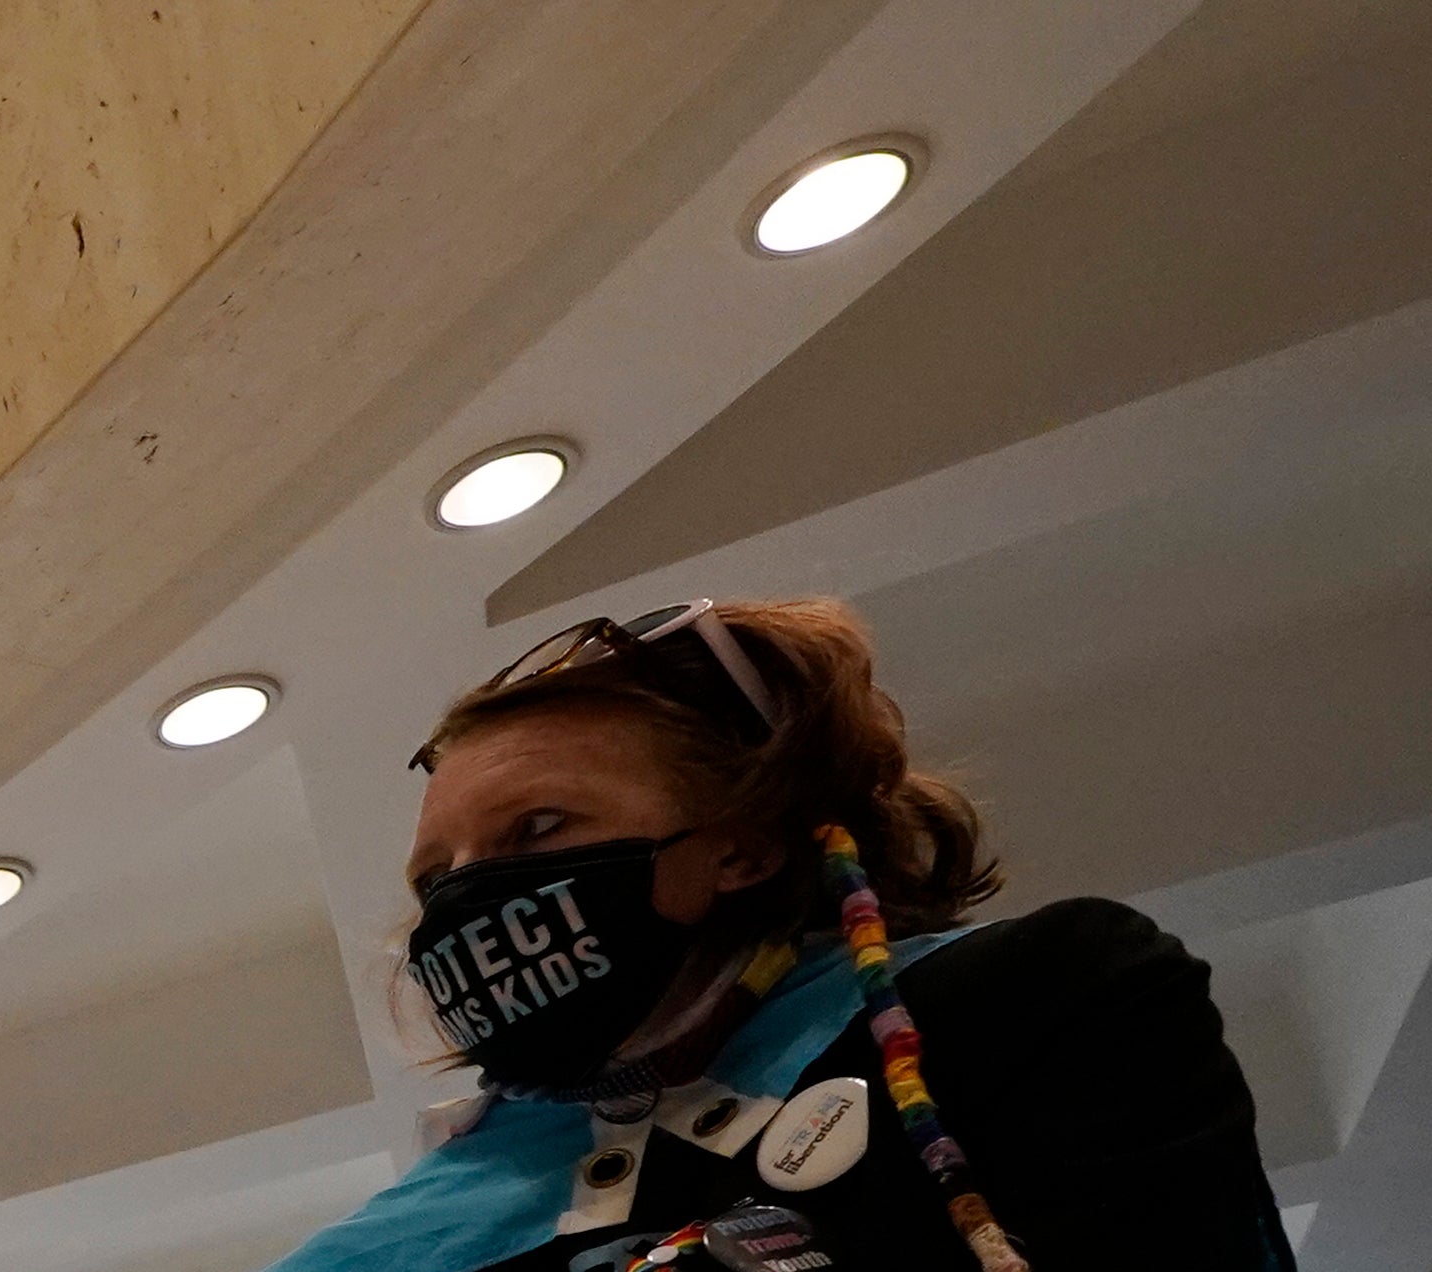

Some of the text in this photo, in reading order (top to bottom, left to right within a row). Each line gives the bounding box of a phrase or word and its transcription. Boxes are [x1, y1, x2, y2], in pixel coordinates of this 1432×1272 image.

[489, 936, 612, 1024] KIDS
[774, 1149, 794, 1169] for
[784, 1098, 854, 1175] liberation!
